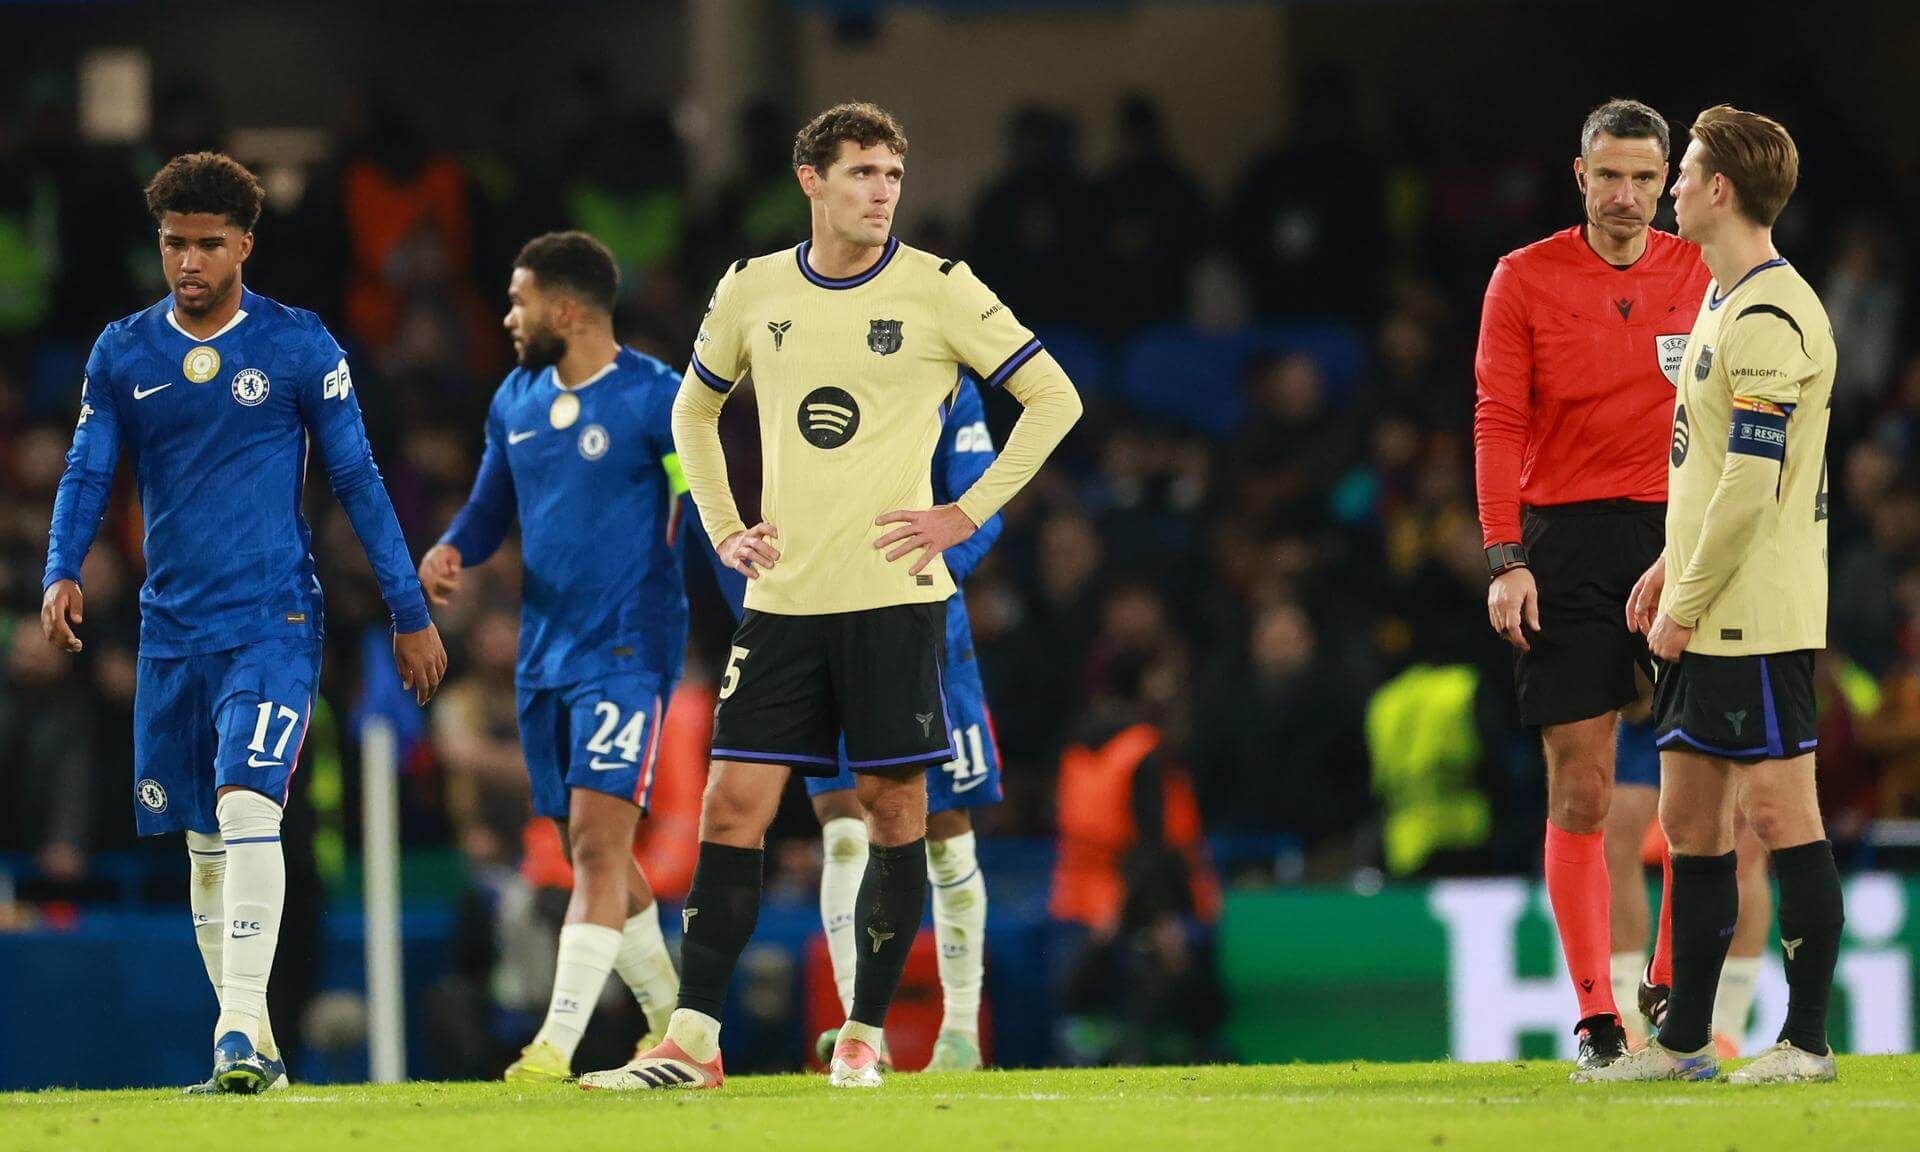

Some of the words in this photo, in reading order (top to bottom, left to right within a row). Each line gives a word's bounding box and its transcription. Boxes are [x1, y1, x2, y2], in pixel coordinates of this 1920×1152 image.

[1730, 368, 1777, 377] AMBILIGHT
[247, 701, 299, 760] 17
[586, 701, 646, 763] 24
[942, 723, 988, 780] 41
[233, 920, 261, 930] CFC
